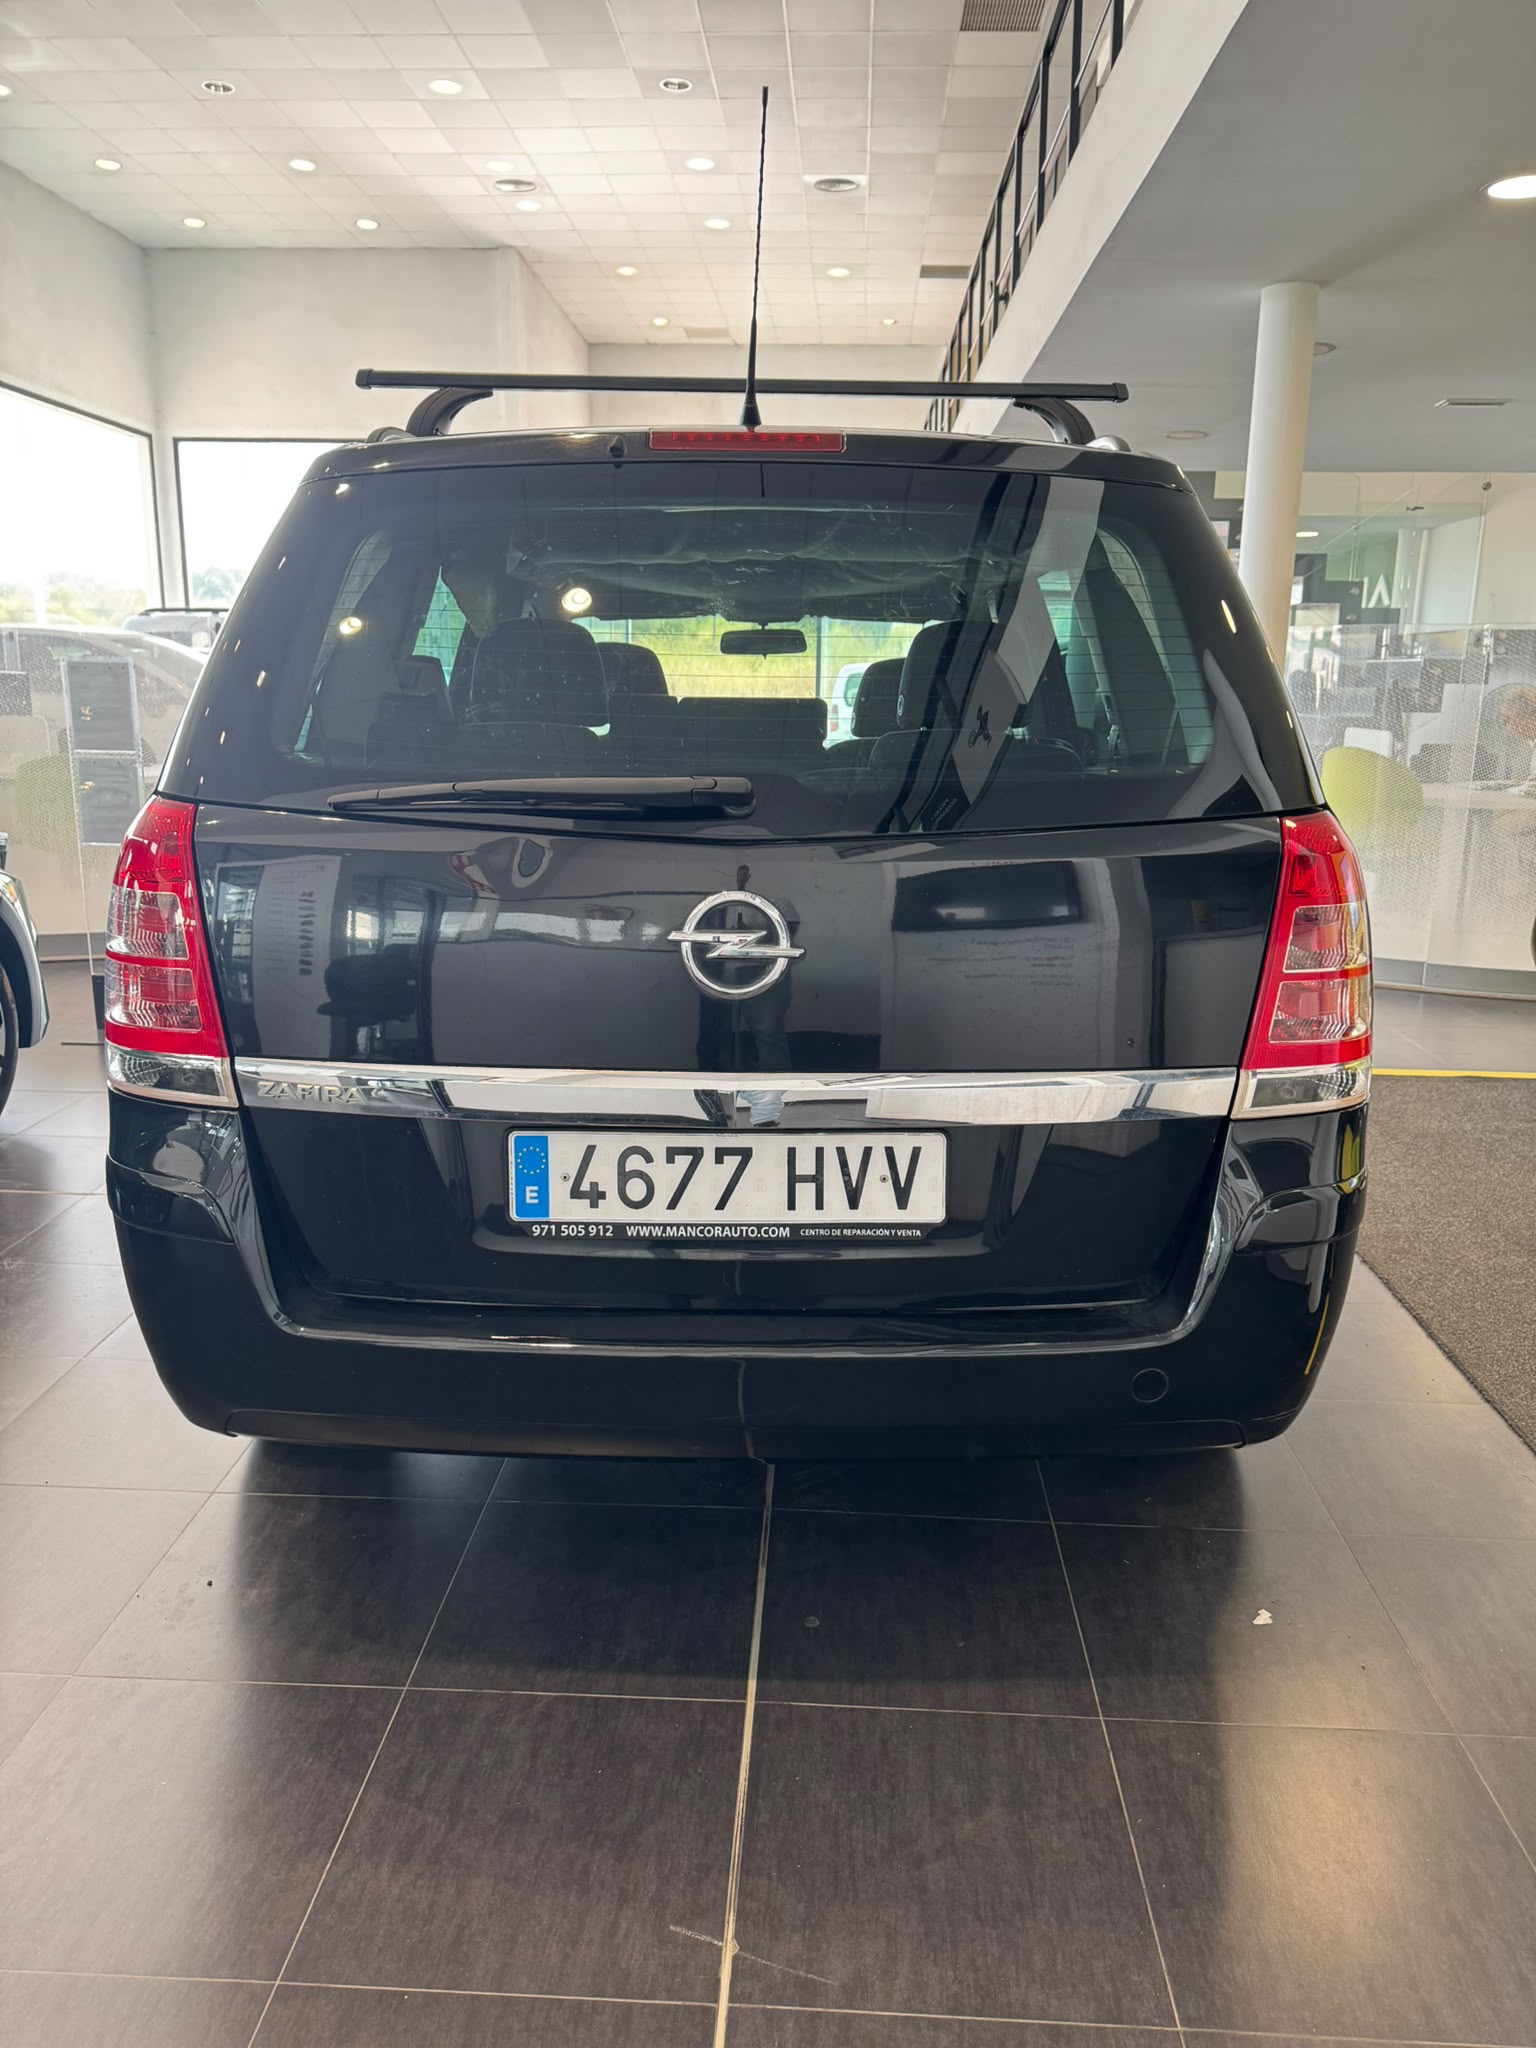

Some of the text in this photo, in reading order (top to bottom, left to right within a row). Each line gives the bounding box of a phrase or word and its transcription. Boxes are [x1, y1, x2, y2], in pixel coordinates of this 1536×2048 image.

[257, 1081, 369, 1105] ZAFIRA
[569, 1144, 754, 1211] 4677
[787, 1145, 922, 1211] HVV
[525, 1186, 539, 1204] E
[532, 1225, 790, 1238] 971 505 912 WWW.MANCORAUTO.COM
[800, 1228, 830, 1237] CENTRO
[831, 1229, 842, 1237] DE
[843, 1227, 890, 1237] REPARACIÓN
[897, 1229, 922, 1237] VENTA
